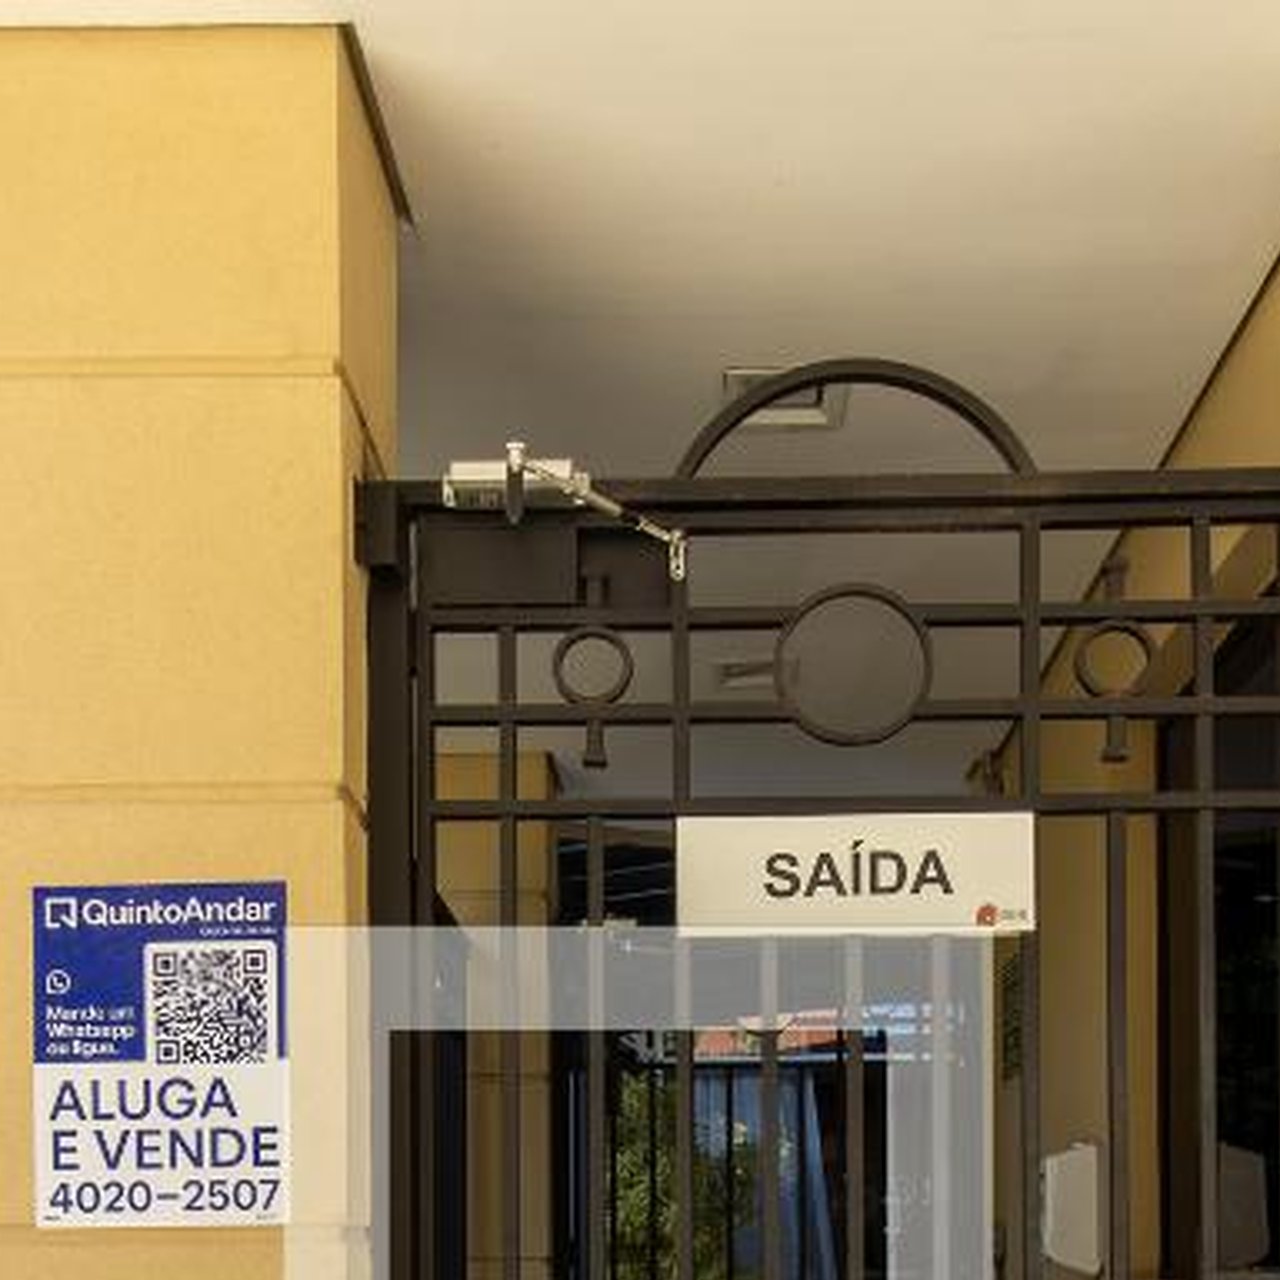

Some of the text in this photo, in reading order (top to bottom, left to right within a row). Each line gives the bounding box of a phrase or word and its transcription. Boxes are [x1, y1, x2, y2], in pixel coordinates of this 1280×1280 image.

[763, 839, 954, 898] SAÍDA
[82, 896, 278, 927] QuintoAndar
[49, 1078, 239, 1121] ALUGA
[52, 1126, 282, 1171] E VENDE
[50, 1178, 281, 1213] 4020-2507
